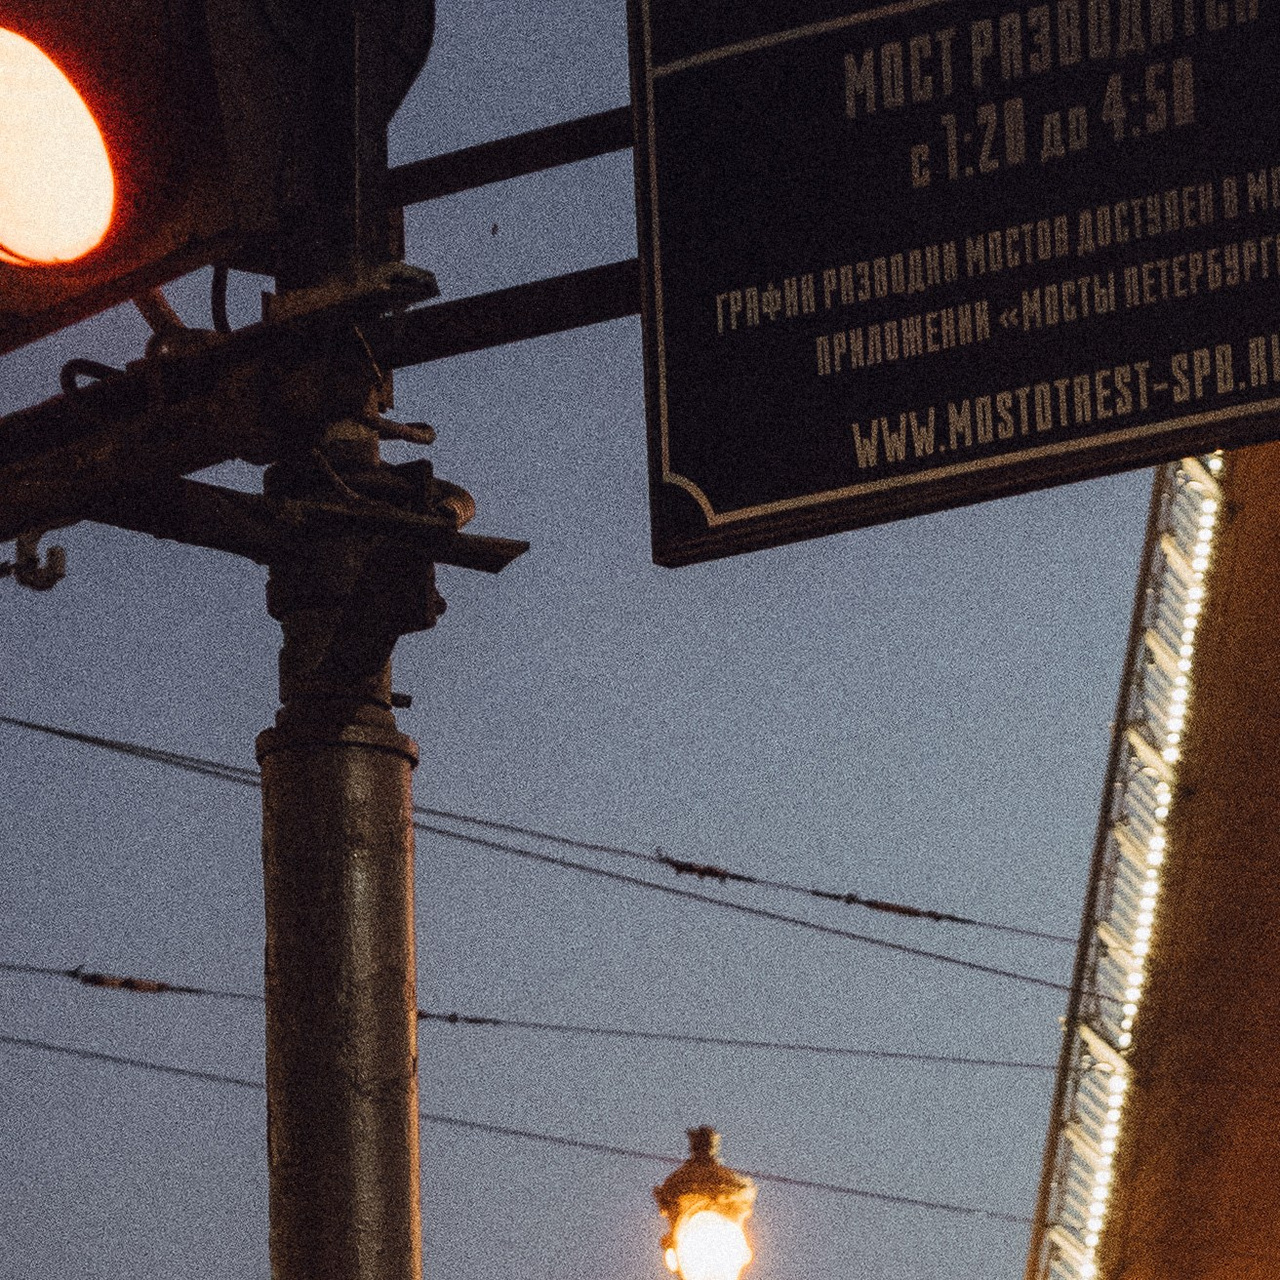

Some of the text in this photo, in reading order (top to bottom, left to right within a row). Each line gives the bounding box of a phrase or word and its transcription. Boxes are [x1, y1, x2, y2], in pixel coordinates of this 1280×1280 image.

[843, 26, 957, 119] МОСТ
[940, 97, 1026, 180] 1:20
[1040, 105, 1089, 164] до
[1101, 55, 1196, 142] 4:50
[715, 272, 817, 337] ГРАФИК
[822, 240, 960, 310] РАЗВОДКИ
[964, 212, 1070, 278] МОСТОВ
[1076, 182, 1215, 257] ДОСТУПЕН
[1222, 175, 1240, 220] В
[815, 299, 992, 377] ПРИЛОЖЕНИИ
[999, 270, 1117, 333] «МОСТЫ
